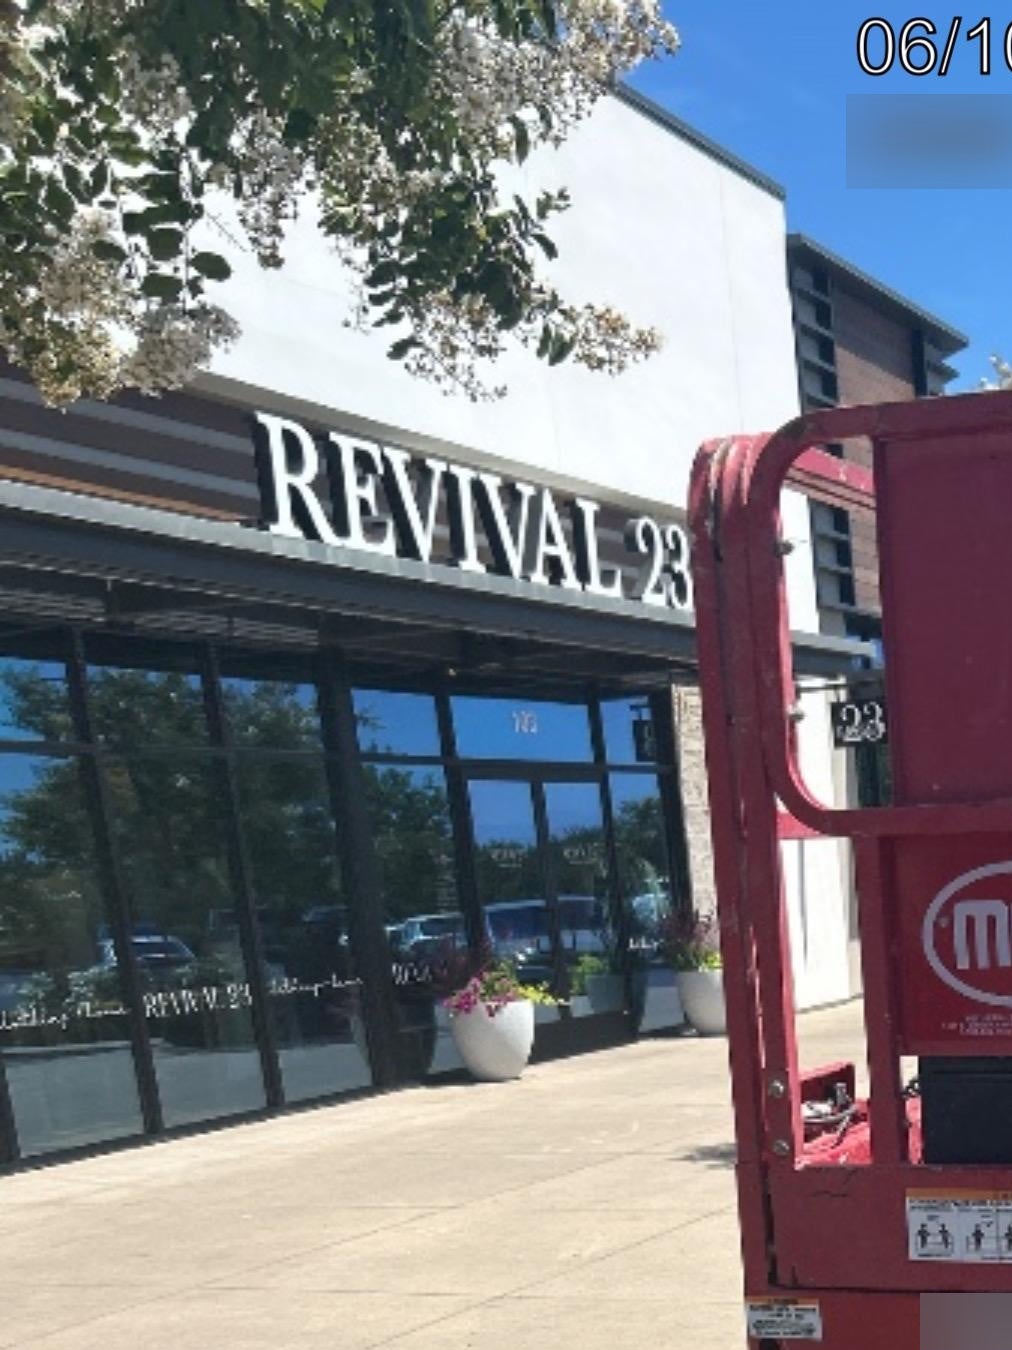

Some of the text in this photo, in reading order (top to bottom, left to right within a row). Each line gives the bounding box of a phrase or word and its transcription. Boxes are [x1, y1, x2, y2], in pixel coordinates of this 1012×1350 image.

[253, 410, 695, 611] REVIVAL 23
[837, 701, 886, 742] 23
